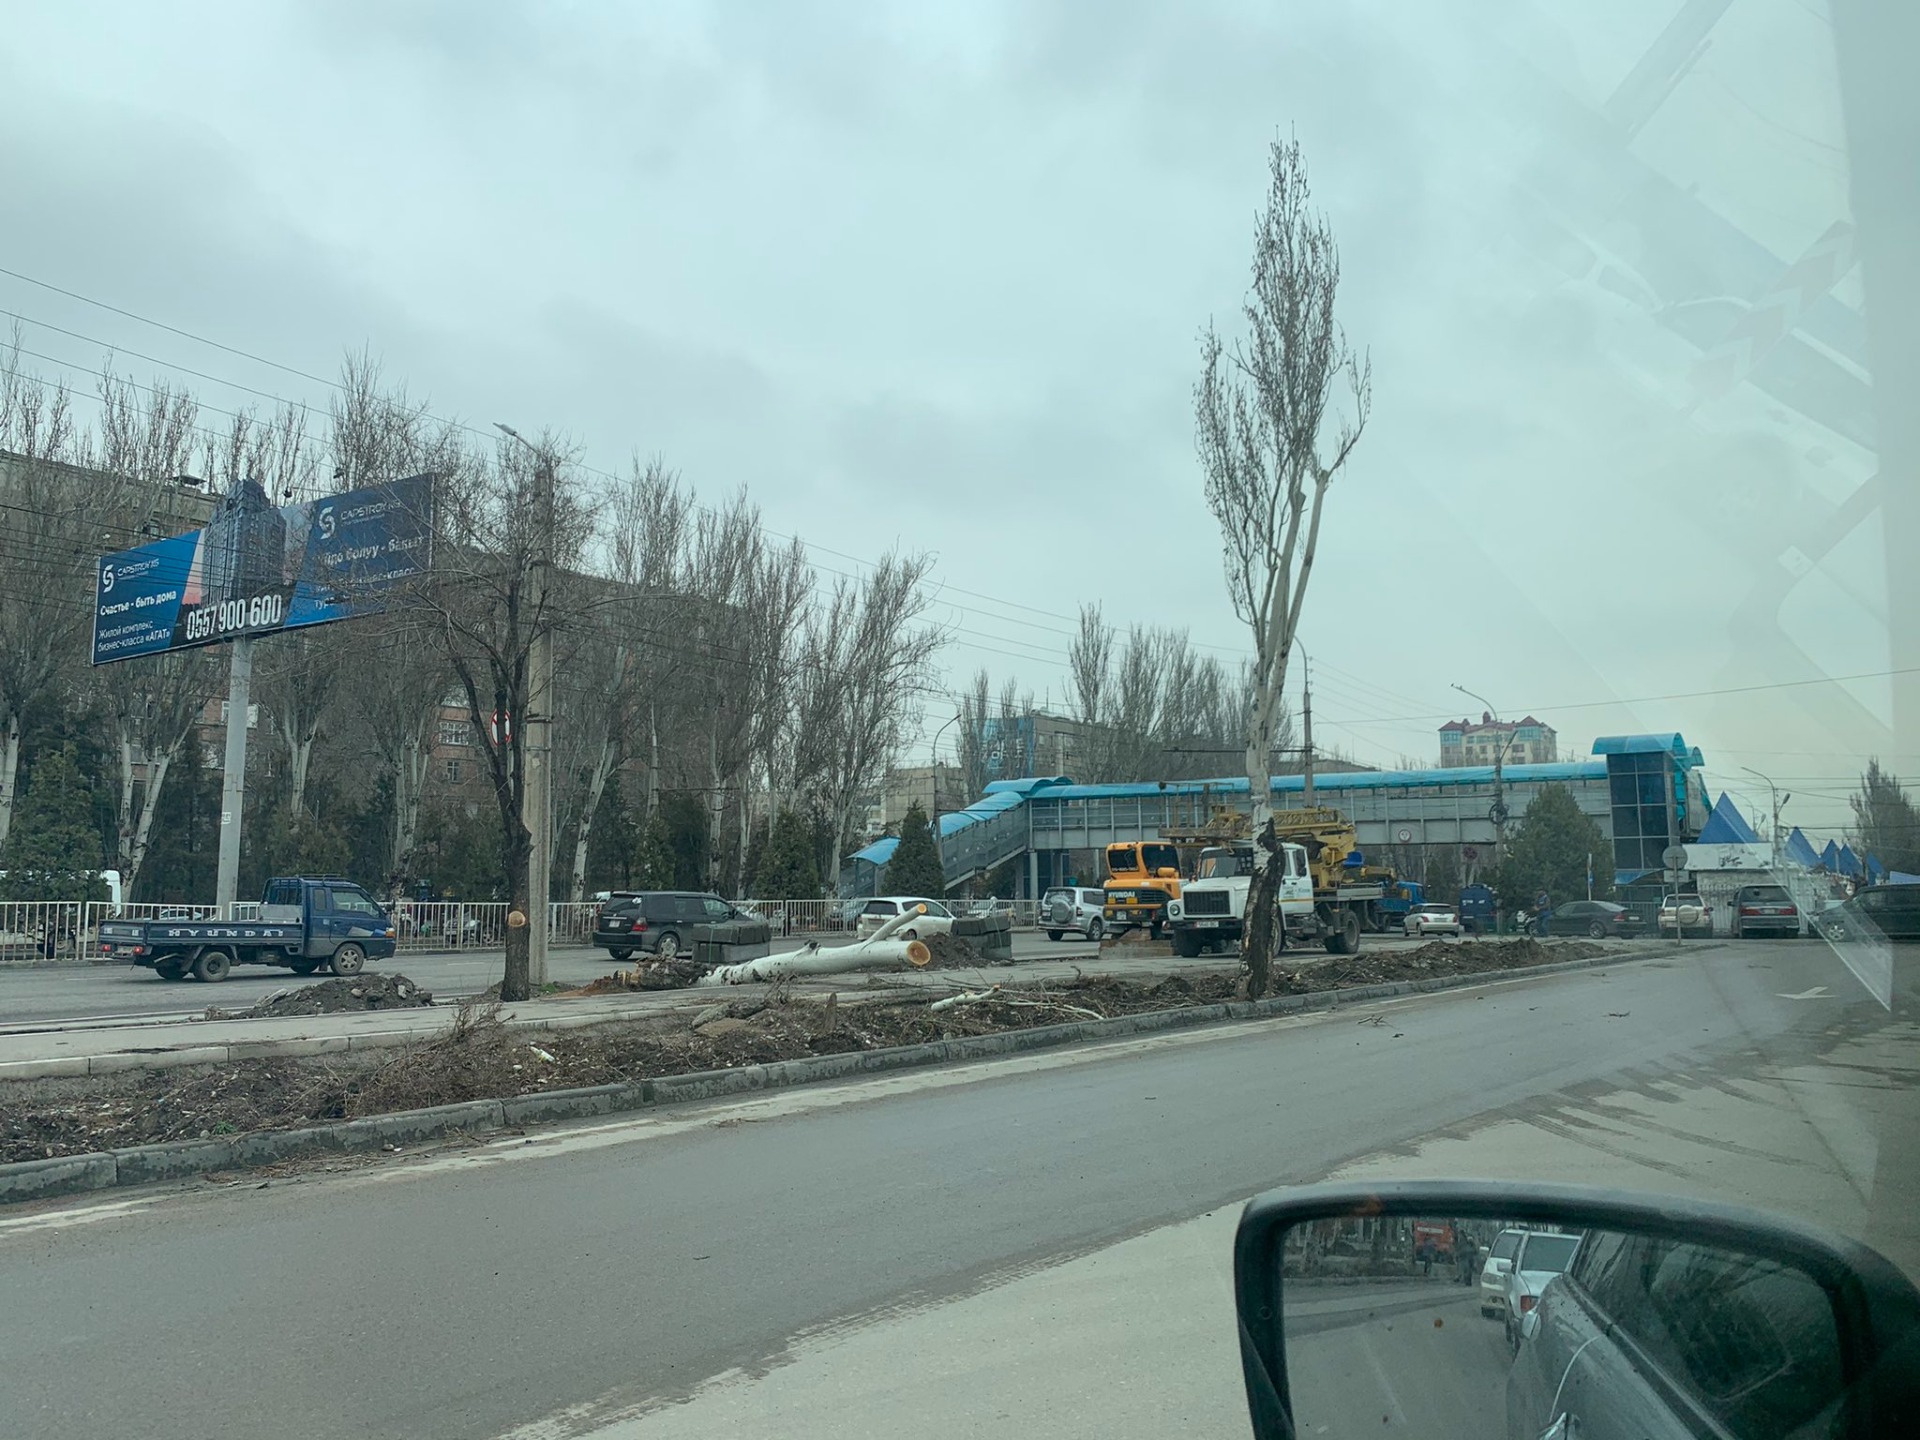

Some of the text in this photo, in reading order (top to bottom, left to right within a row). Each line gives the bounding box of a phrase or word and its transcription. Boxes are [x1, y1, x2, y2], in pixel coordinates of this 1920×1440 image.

[100, 601, 130, 616] Счастье
[135, 596, 155, 608] быть
[155, 590, 177, 605] дома
[186, 594, 282, 641] 0557 900 600
[98, 620, 154, 640] Жилой комплекс
[97, 635, 145, 653] бизнес-класса
[168, 928, 285, 938] HYUNDAI
